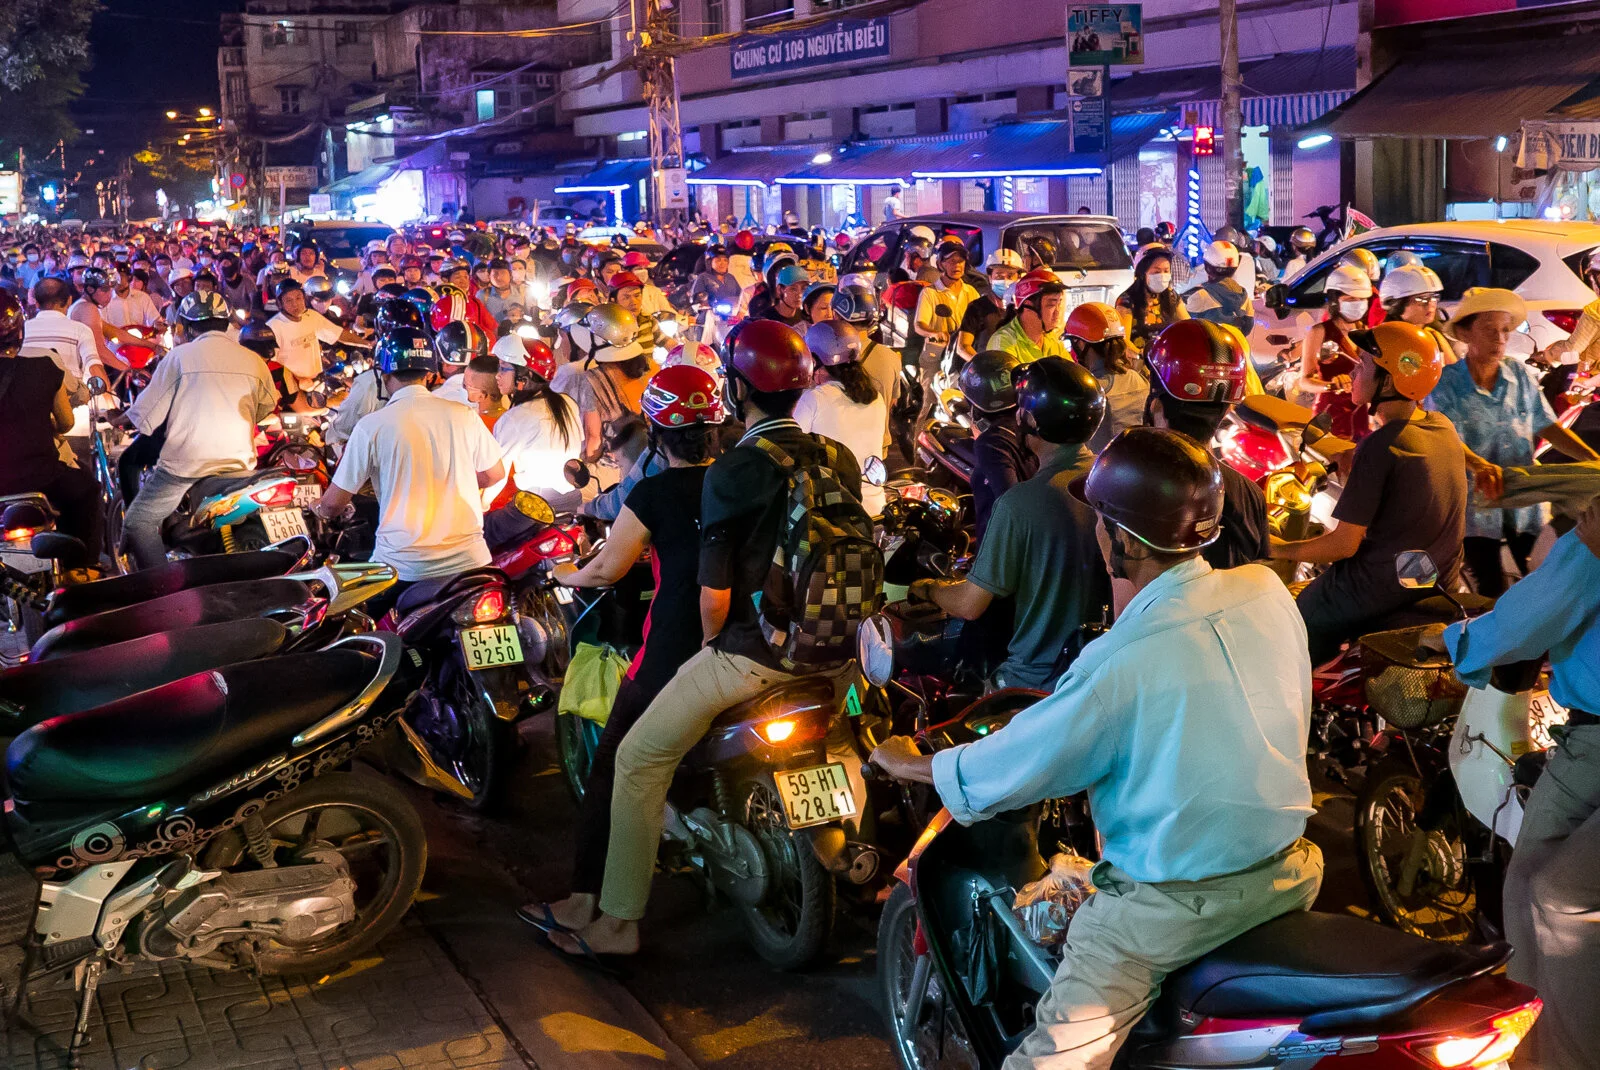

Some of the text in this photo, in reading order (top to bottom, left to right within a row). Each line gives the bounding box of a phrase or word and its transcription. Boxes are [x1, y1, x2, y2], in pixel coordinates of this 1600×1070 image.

[1072, 9, 1122, 23] TIFFY
[734, 46, 766, 70] CHUNG
[768, 40, 782, 64] CƯ
[785, 39, 804, 62] 109
[807, 22, 853, 58] NGUYỄN
[1590, 133, 1600, 158] Đ
[267, 511, 298, 527] 54-L1
[273, 524, 304, 540] 4800
[469, 627, 511, 647] 54-V4
[473, 645, 516, 666] 9250
[787, 768, 838, 797] 59-H1
[790, 790, 851, 823] 428.41
